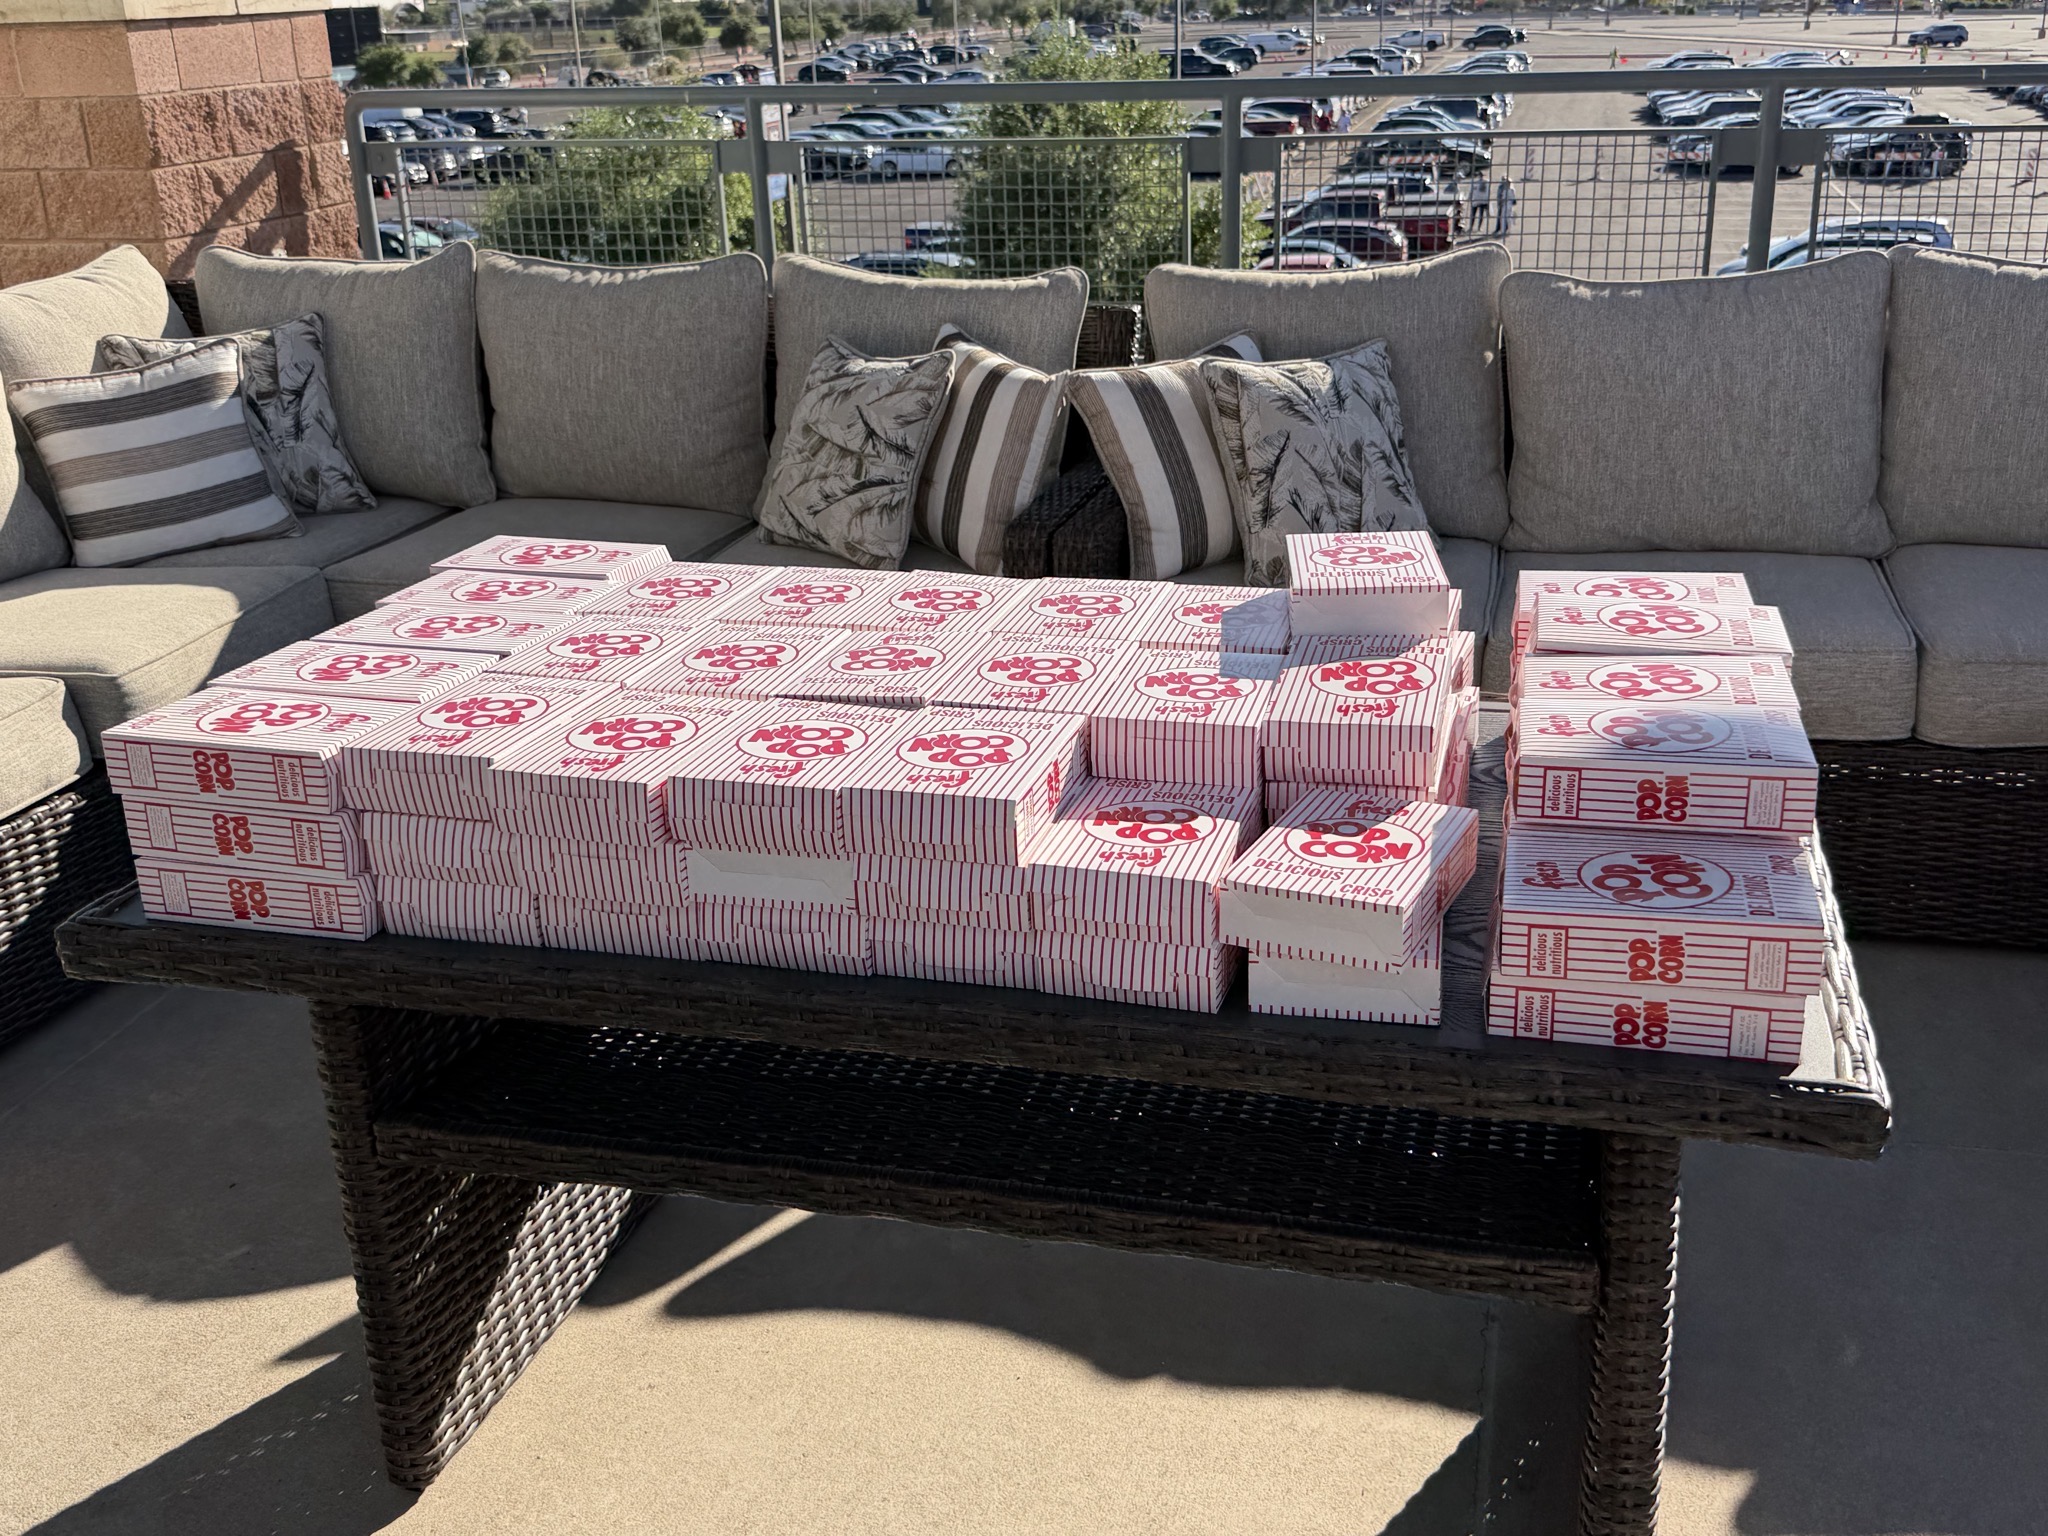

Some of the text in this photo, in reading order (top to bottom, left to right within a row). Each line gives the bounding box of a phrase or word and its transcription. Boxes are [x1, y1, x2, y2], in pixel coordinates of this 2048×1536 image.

[1319, 546, 1387, 558] POP
[1330, 552, 1416, 566] CORN
[637, 577, 721, 589] CORN
[769, 584, 852, 597] CORN
[1585, 584, 1629, 597] OP
[650, 588, 715, 598] POP
[783, 594, 849, 605] POP
[898, 589, 982, 600] CORN
[1038, 595, 1123, 607] CORN
[914, 600, 981, 611] POP
[1056, 605, 1124, 617] POP
[404, 616, 460, 638] CORN
[453, 616, 501, 634] POP
[1043, 619, 1096, 632] fresh
[1608, 610, 1667, 635] POP
[1639, 604, 1705, 633] CORN
[557, 634, 652, 646] CORN
[882, 634, 935, 644] fresh
[571, 644, 645, 657] POP
[692, 645, 786, 659] CORN
[846, 646, 917, 660] POP
[1043, 644, 1115, 654] DELICIOUS
[1366, 645, 1445, 655] DELICIOUS
[308, 655, 370, 681] CORN
[357, 655, 413, 675] POP
[545, 660, 602, 673] fresh
[708, 656, 782, 670] POP
[841, 657, 937, 671] CORN
[987, 657, 1082, 672] CORN
[1320, 661, 1417, 682] CORN
[685, 673, 743, 687] fresh
[801, 677, 877, 685] DELICIOUS
[1006, 669, 1083, 685] POP
[1145, 672, 1240, 687] CORN
[1344, 675, 1424, 695] POP
[1599, 672, 1662, 697] POP
[1632, 665, 1703, 693] CORN
[990, 688, 1051, 703] fresh
[1166, 685, 1244, 700] POP
[429, 697, 538, 714] CORN
[778, 701, 823, 709] CRISP
[930, 709, 976, 718] CRISP
[1155, 703, 1217, 718] fresh
[1337, 699, 1400, 718] fresh
[210, 702, 279, 733] CORN
[280, 703, 323, 727] POP
[443, 710, 526, 728] POP
[817, 710, 898, 723] DELICIOUS
[578, 718, 687, 735] CORN
[747, 725, 854, 742] CORN
[972, 720, 1054, 730] DELICIOUS
[1536, 715, 1590, 736] fresh
[1601, 716, 1669, 747] POP
[1635, 709, 1714, 744] CORN
[409, 731, 473, 747] fresh
[593, 732, 676, 750] POP
[907, 734, 1014, 752] CORN
[766, 740, 849, 758] POP
[928, 748, 1013, 767] POP
[192, 750, 217, 793] CORN
[210, 751, 236, 791] POP
[560, 754, 625, 772] fresh
[740, 762, 806, 778] fresh
[276, 758, 289, 798] nutritious
[287, 762, 301, 797] delicious
[906, 770, 973, 788] fresh
[1105, 780, 1153, 789] CRISP
[1152, 791, 1235, 804] DELICIOUS
[1547, 774, 1562, 812] delicious
[1566, 773, 1576, 815] nutritious
[1636, 778, 1664, 821] POP
[1663, 775, 1690, 822] CORN
[1093, 806, 1199, 826] CORN
[1344, 800, 1409, 817] fresh
[211, 812, 235, 856] CORN
[229, 815, 254, 855] POP
[1115, 824, 1202, 844] POP
[1305, 821, 1390, 843] POP
[294, 823, 308, 863] nutritious
[306, 826, 318, 862] delicious
[1299, 841, 1413, 863] CORN
[1099, 848, 1167, 867] fresh
[1770, 855, 1797, 876] CRISP
[1252, 858, 1344, 880] DELICIOUS
[1522, 860, 1580, 889] fresh
[1630, 854, 1713, 899] CORN
[1340, 884, 1393, 898] CRISP
[1591, 864, 1664, 902] POP
[227, 878, 252, 920] CORN
[244, 880, 270, 918] POP
[1742, 874, 1775, 916] DELICIOUS
[311, 888, 325, 926] nutritious
[323, 891, 335, 925] delicious
[1532, 933, 1548, 971] delicious
[1552, 931, 1563, 974] nutritious
[1628, 938, 1657, 981] POP
[1657, 935, 1685, 983] CORN
[1519, 995, 1534, 1032] delicious
[1540, 994, 1549, 1035] nutritious
[1613, 1003, 1641, 1045] POP
[1641, 1000, 1669, 1048] CORN
